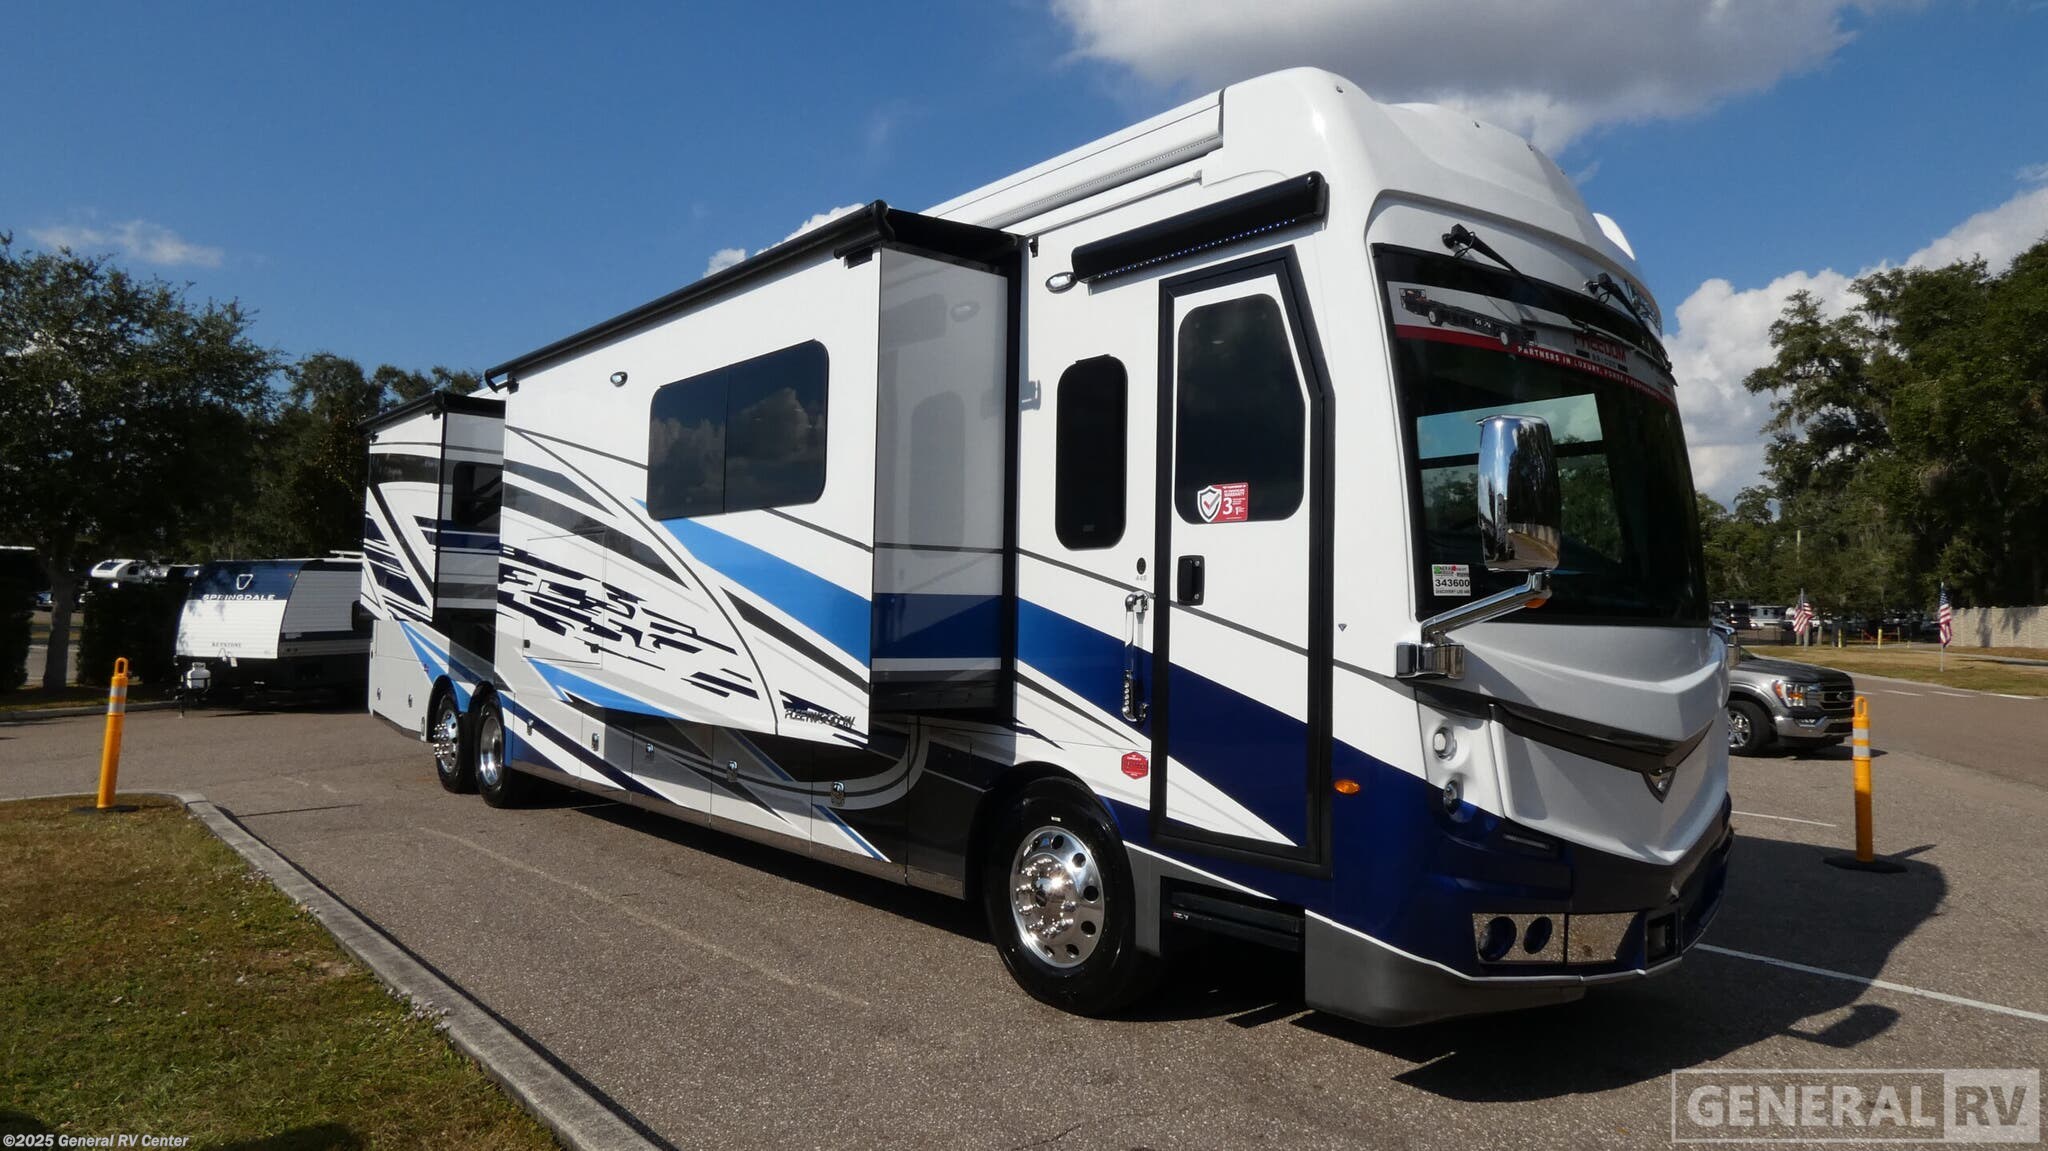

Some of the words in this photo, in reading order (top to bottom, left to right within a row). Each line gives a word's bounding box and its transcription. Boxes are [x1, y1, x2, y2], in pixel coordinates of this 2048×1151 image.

[1518, 345, 1560, 362] PARTNERS
[1562, 354, 1572, 366] IN
[1222, 497, 1233, 515] 3
[1435, 579, 1470, 588] 343600
